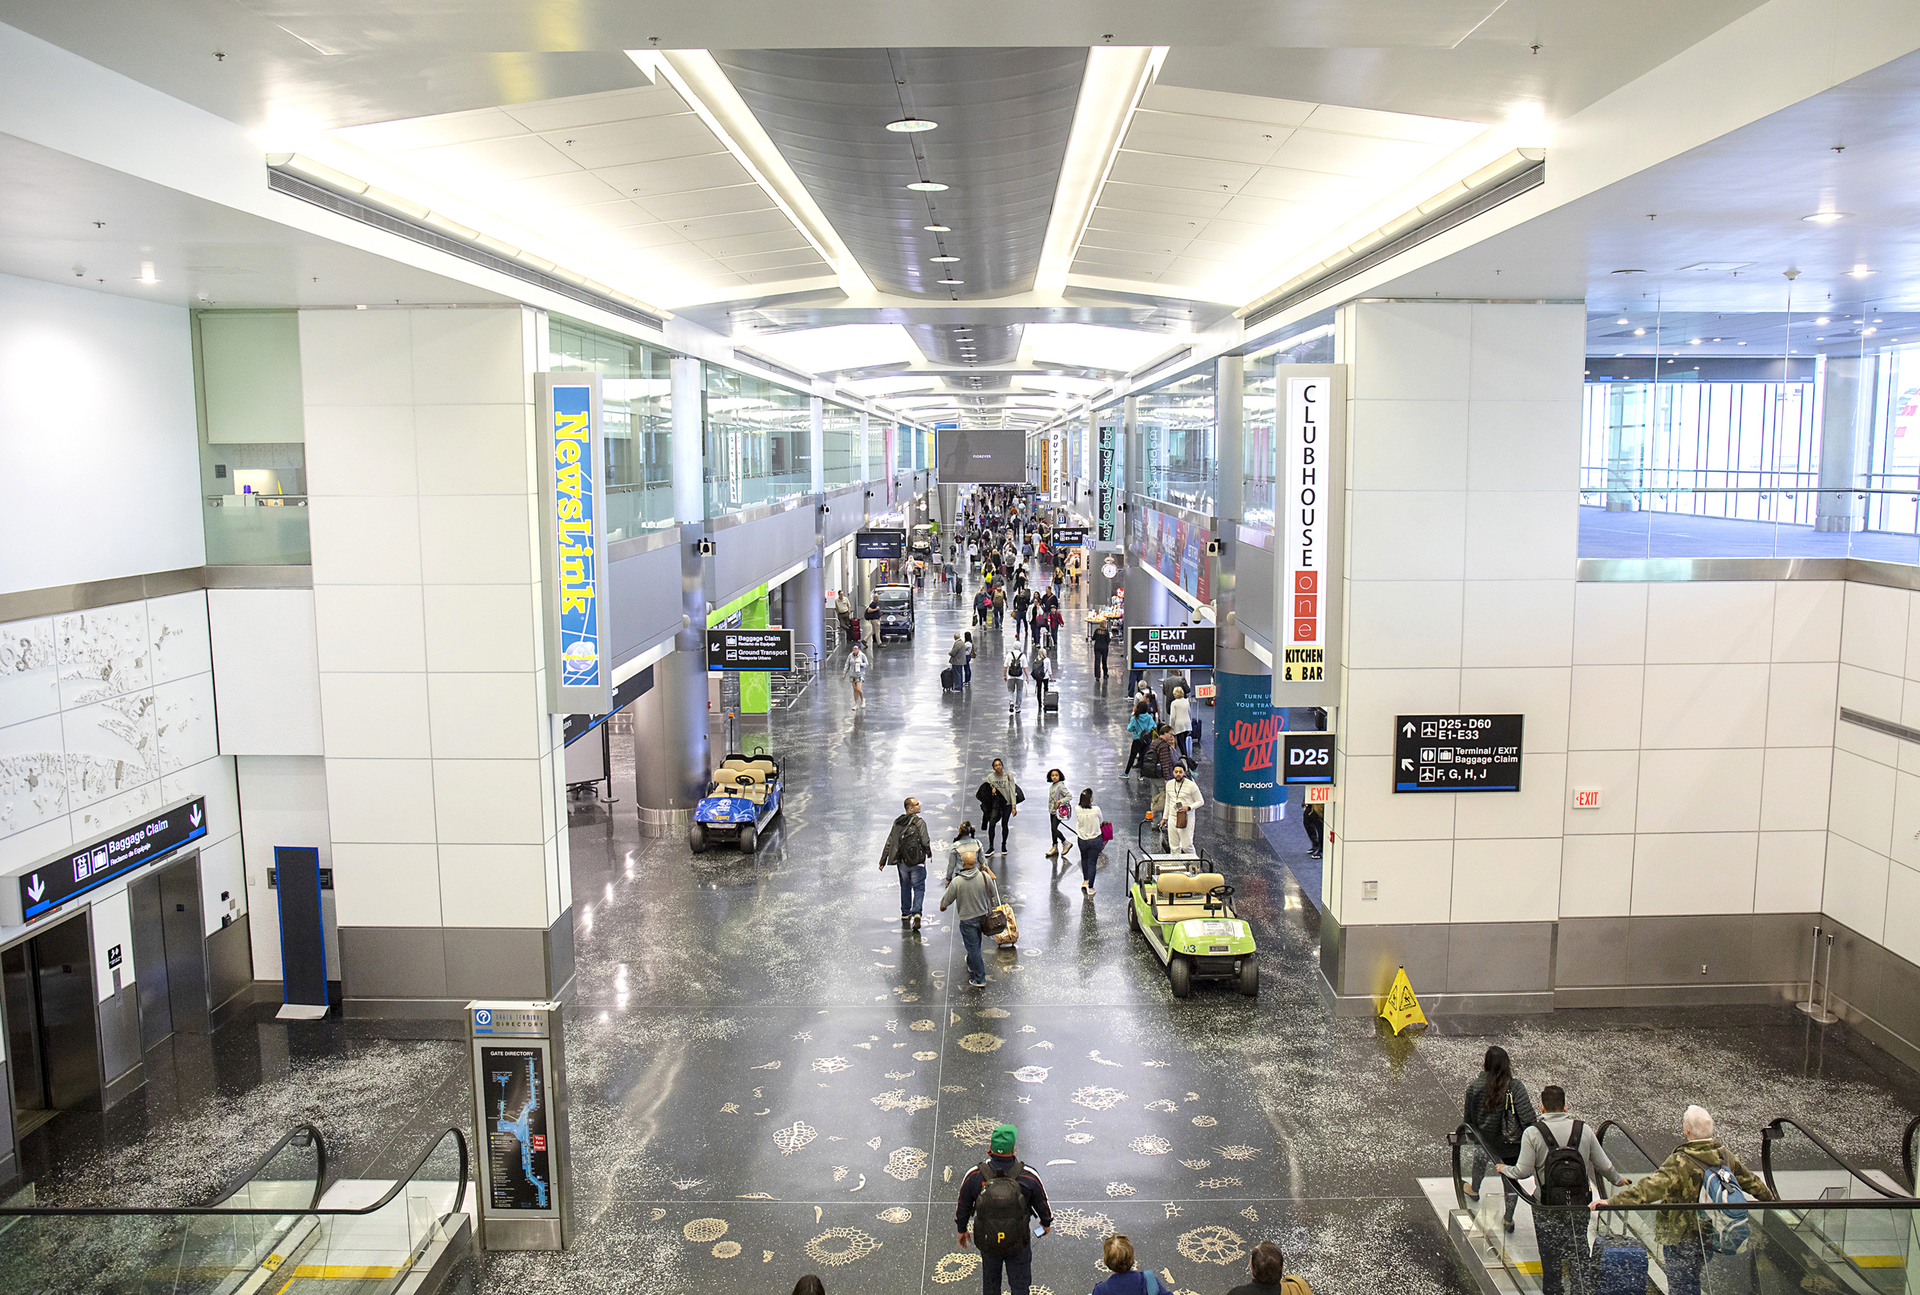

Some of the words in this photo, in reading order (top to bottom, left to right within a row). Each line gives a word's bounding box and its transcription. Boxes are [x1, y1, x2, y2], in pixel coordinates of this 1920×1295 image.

[1102, 430, 1112, 476] BOOKS
[1301, 385, 1316, 567] CLUBHOUSE
[1102, 479, 1112, 490] &
[555, 411, 594, 614] NewsLink
[1102, 493, 1112, 538] BOOKS
[1299, 576, 1312, 637] one
[1161, 630, 1187, 640] EXIT
[1161, 655, 1167, 663] F,
[1169, 654, 1178, 663] G,
[1179, 655, 1188, 663] H,
[1286, 649, 1323, 663] KITCHEN
[1285, 667, 1292, 681] &
[1302, 667, 1322, 680] BAR
[1199, 687, 1212, 696] EXIT
[1229, 714, 1284, 746] SOUND
[1243, 743, 1272, 771] ON
[1290, 748, 1329, 765] D25
[1455, 756, 1492, 765] Baggage
[1437, 769, 1446, 780] F,
[1449, 769, 1461, 780] G,
[1465, 769, 1477, 780] H,
[1480, 769, 1487, 779] J
[1310, 788, 1329, 801] EXIT
[1579, 792, 1598, 805] EXIT
[108, 830, 145, 854] Baggage
[145, 820, 169, 836] Claim
[997, 1232, 1005, 1243] P
